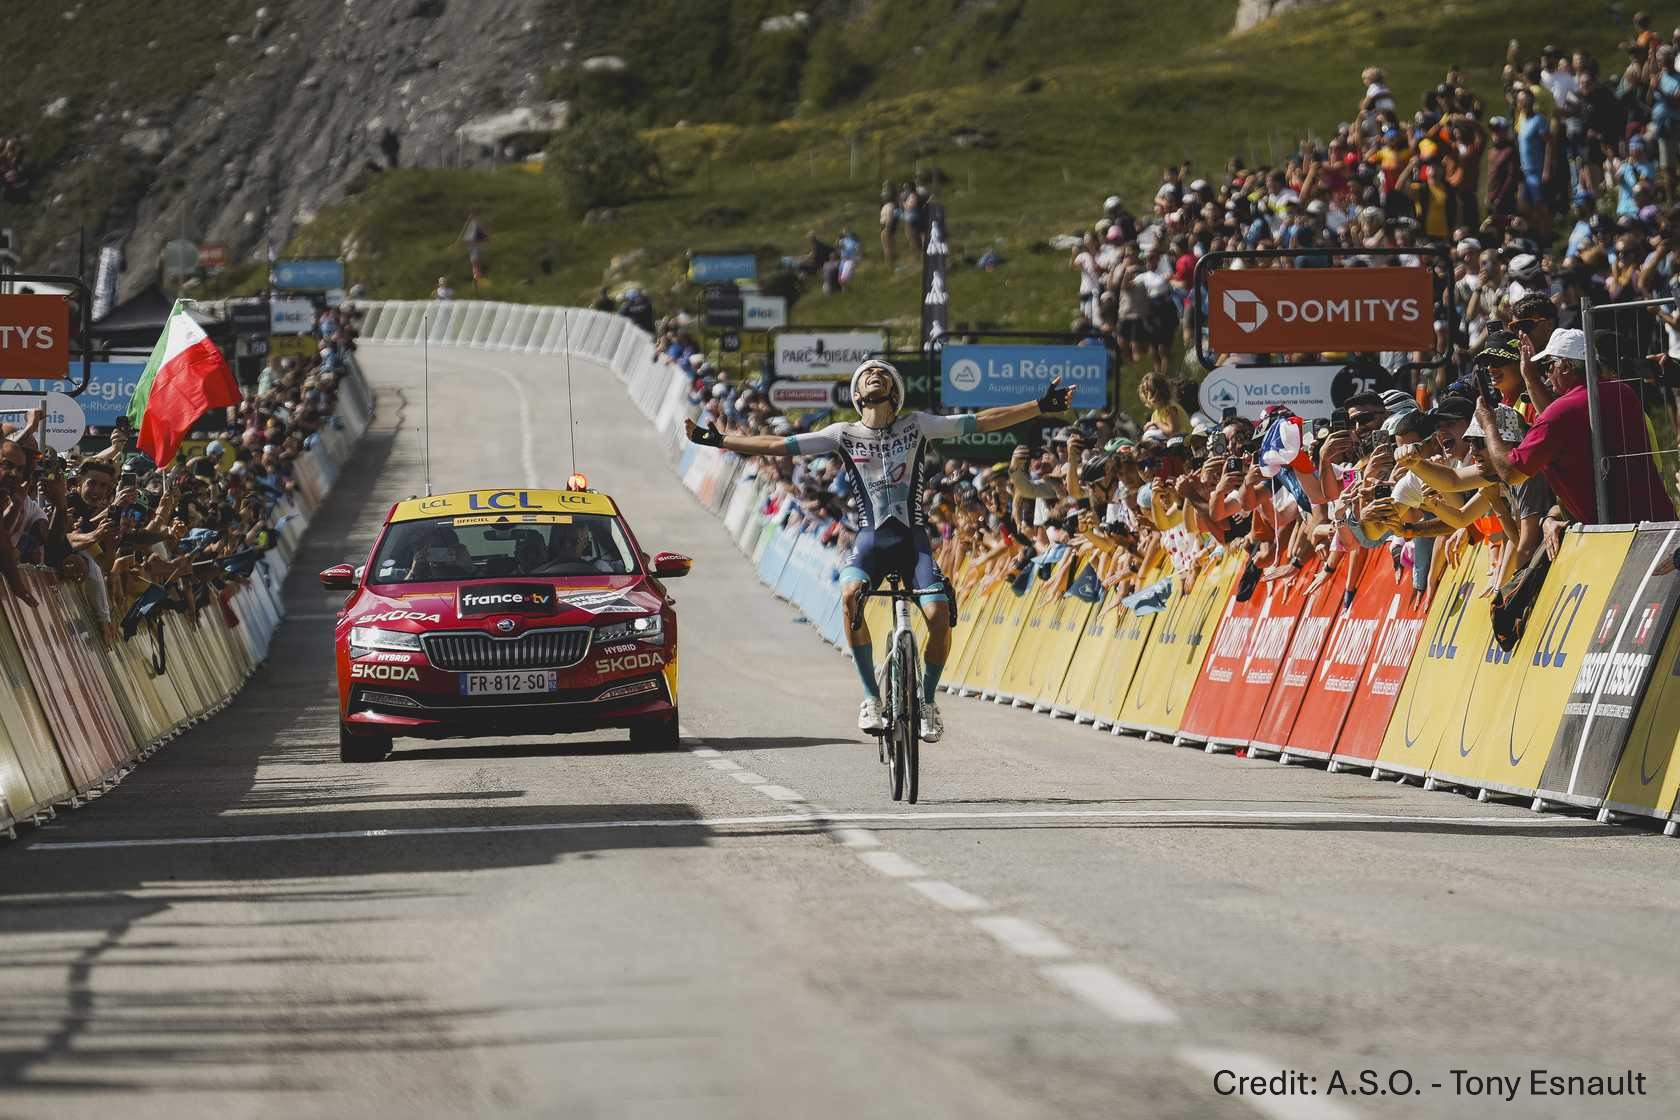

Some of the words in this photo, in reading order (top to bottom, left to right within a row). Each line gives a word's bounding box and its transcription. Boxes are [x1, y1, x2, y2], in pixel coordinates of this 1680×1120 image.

[1277, 299, 1420, 322] DOMITYS
[782, 349, 811, 363] PARC
[988, 360, 1013, 378] La
[1020, 359, 1100, 382] Région
[1244, 383, 1268, 396] Val
[1271, 382, 1312, 395] Cenis
[1351, 378, 1377, 395] 25
[842, 429, 919, 453] BAHRAIN
[469, 491, 543, 510] LCL
[561, 495, 592, 504] LCL
[913, 462, 925, 526] BAHRAIN
[421, 499, 452, 509] LCL
[1532, 583, 1588, 668] LCL
[604, 643, 637, 655] HYBRID
[377, 654, 412, 663] HYBRID
[1603, 652, 1652, 697] TISSOT
